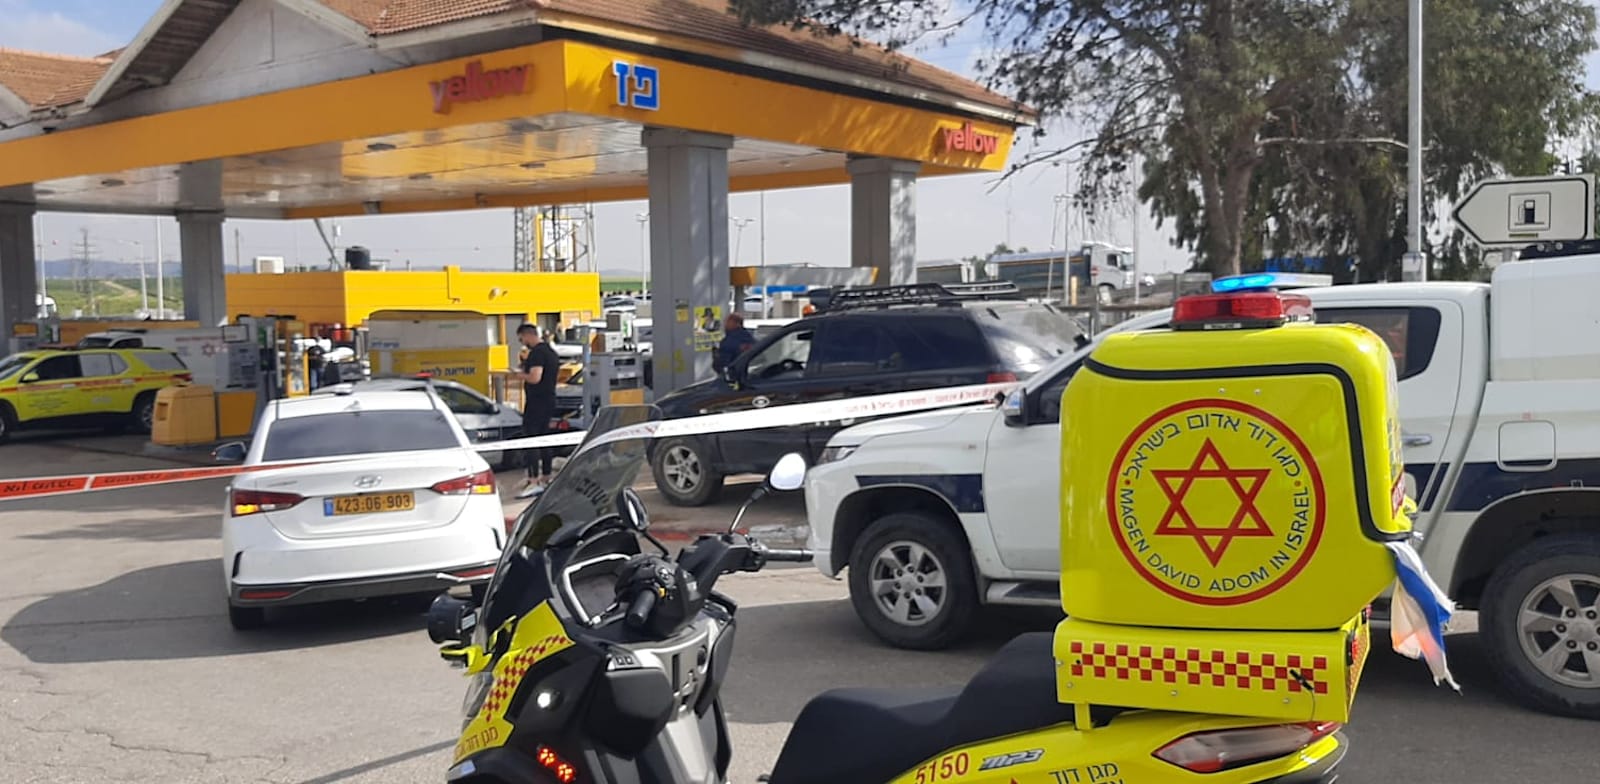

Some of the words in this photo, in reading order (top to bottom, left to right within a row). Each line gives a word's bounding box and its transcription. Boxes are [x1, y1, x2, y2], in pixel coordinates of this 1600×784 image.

[429, 60, 533, 114] yellow
[612, 59, 660, 111] פז
[942, 120, 999, 155] yellow
[1187, 413, 1241, 432] אדום
[1247, 421, 1278, 449] דוד
[1122, 422, 1182, 480] בישראל
[1272, 446, 1302, 478] מגן
[1120, 487, 1150, 553] MAGEN
[1146, 553, 1201, 589] DAVID
[1208, 566, 1270, 592] ADOM
[1269, 550, 1291, 570] IN
[1285, 487, 1310, 551] ISRAEL
[915, 752, 969, 784] 5150
[1048, 768, 1080, 784] דוד
[1086, 763, 1119, 783] מגן
